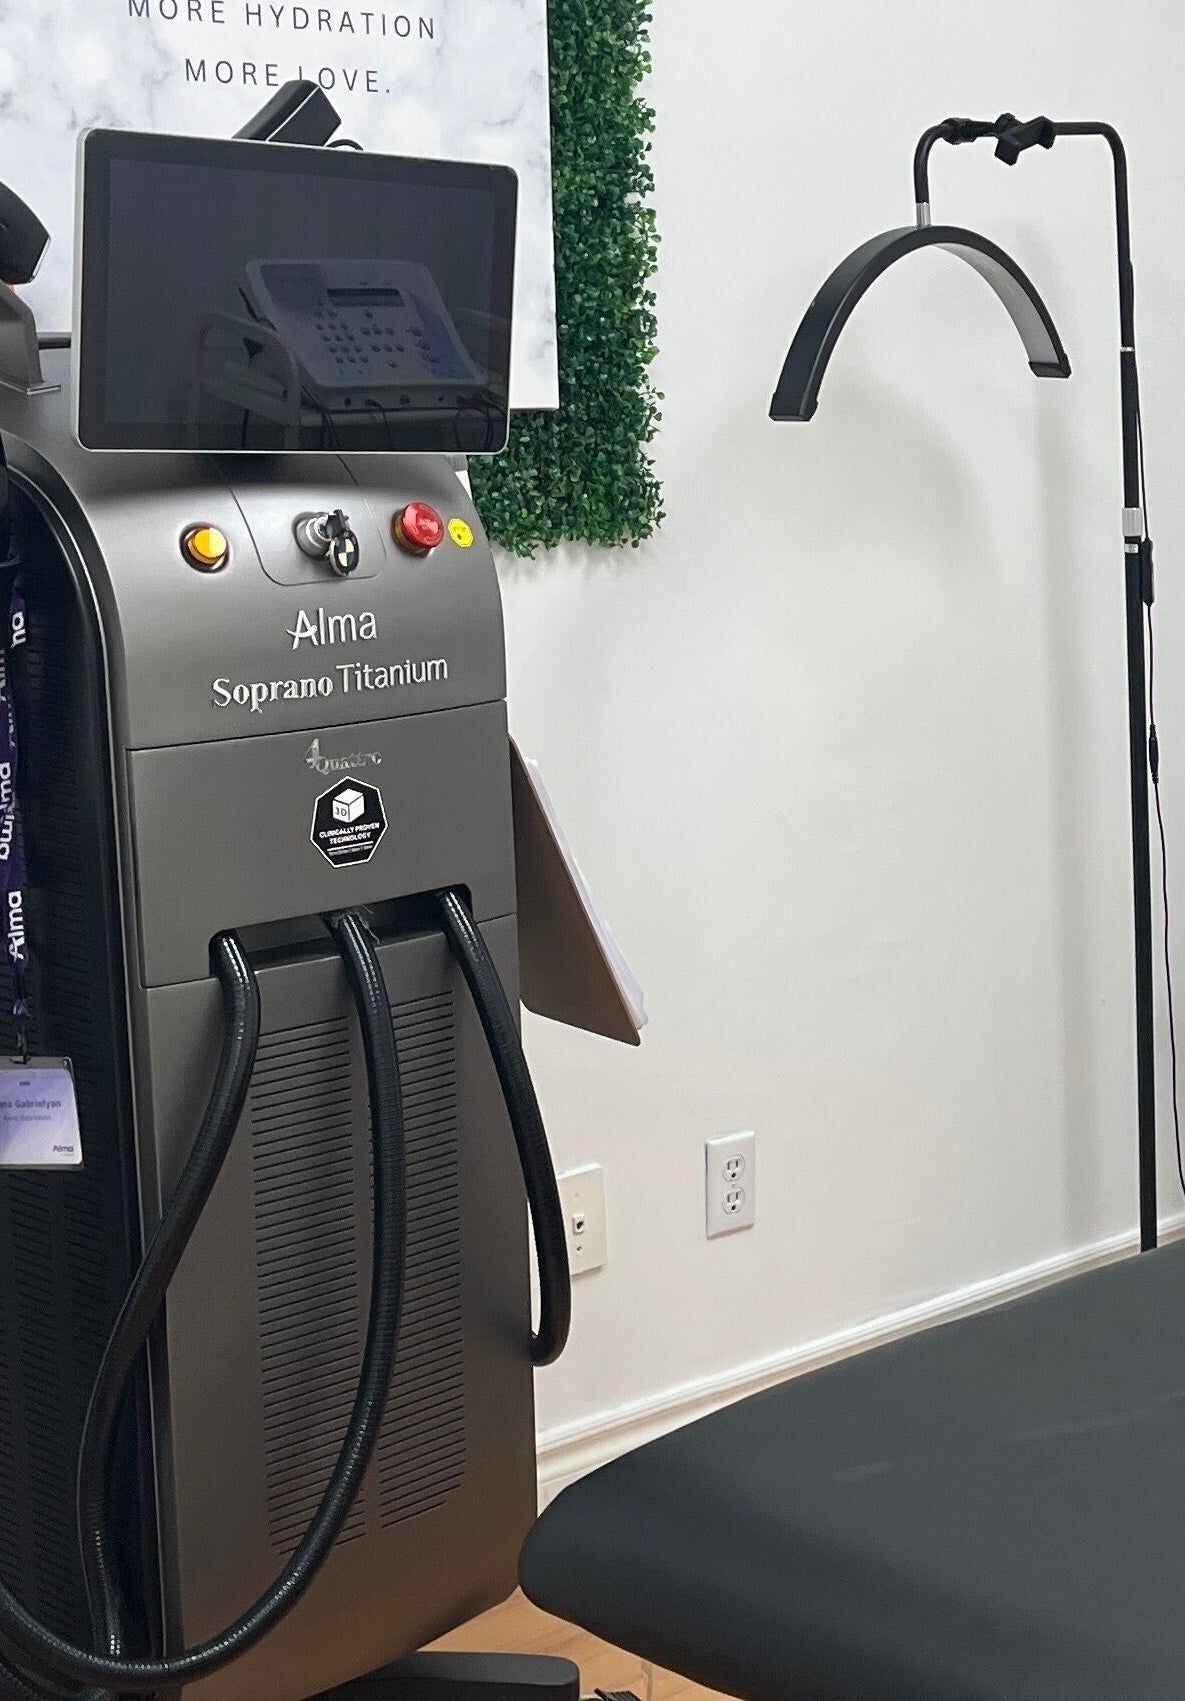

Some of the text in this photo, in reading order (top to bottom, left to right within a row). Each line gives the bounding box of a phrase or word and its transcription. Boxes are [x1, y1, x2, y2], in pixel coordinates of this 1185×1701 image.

[128, 0, 435, 39] MORE HYDRATION
[185, 58, 279, 87] MORE
[286, 607, 378, 650] Alma
[212, 658, 448, 713] Soprano Titanium
[335, 806, 348, 817] 3D
[318, 822, 380, 839] CLINICALLY PROVEN
[329, 831, 371, 845] TECHNOLOGY
[8, 890, 25, 962] Alma
[53, 1144, 74, 1153] Alma
